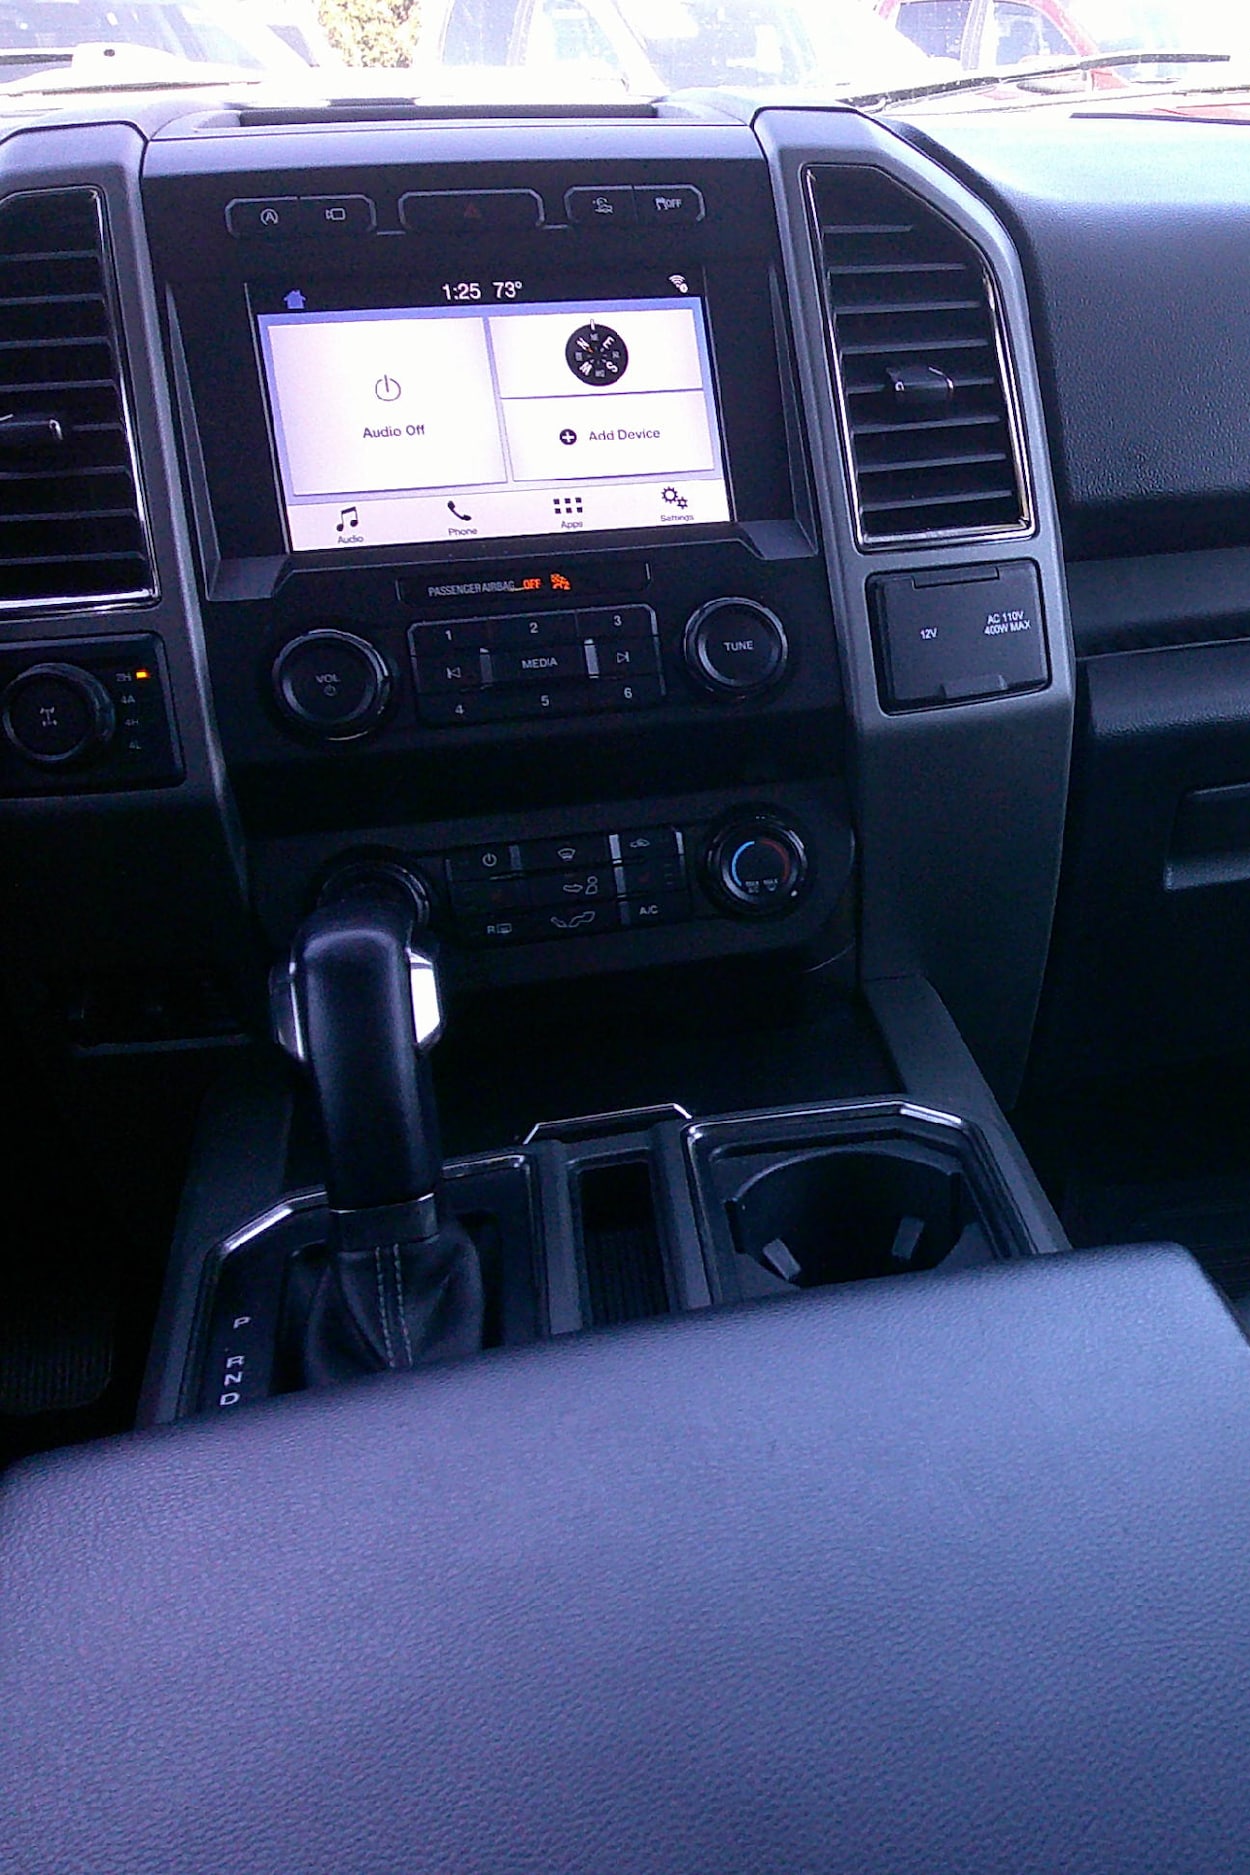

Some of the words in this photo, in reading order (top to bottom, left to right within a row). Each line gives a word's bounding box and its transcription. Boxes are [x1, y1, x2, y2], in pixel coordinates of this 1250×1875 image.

[664, 199, 682, 208] OFF
[442, 283, 482, 300] 1:25
[492, 281, 523, 298] 73°
[362, 426, 402, 438] Audio
[405, 424, 425, 436] Off
[588, 430, 615, 441] Add
[617, 428, 661, 440] Device
[660, 514, 695, 522] Settings
[560, 520, 583, 529] Apps
[448, 527, 478, 536] Phone
[337, 534, 364, 544] Audio
[427, 584, 482, 597] PASSENGER
[482, 580, 515, 592] AIRBAG
[522, 578, 543, 589] OFF
[613, 615, 622, 627] 3
[986, 614, 1001, 625] AC
[1002, 611, 1024, 622] 110V
[529, 622, 539, 634] 2
[919, 627, 938, 640] 12V
[983, 623, 1008, 635] 400W
[1010, 620, 1031, 631] MAX
[445, 630, 453, 641] 1
[723, 640, 754, 652] TUNE
[521, 657, 558, 669] MEDIA
[315, 673, 340, 683] VOL
[623, 687, 633, 699] 6
[540, 694, 550, 707] 5
[455, 704, 465, 714] 4
[639, 905, 659, 915] A/C
[232, 1316, 251, 1329] P
[226, 1355, 245, 1368] R
[224, 1371, 243, 1386] N
[219, 1392, 241, 1406] D
